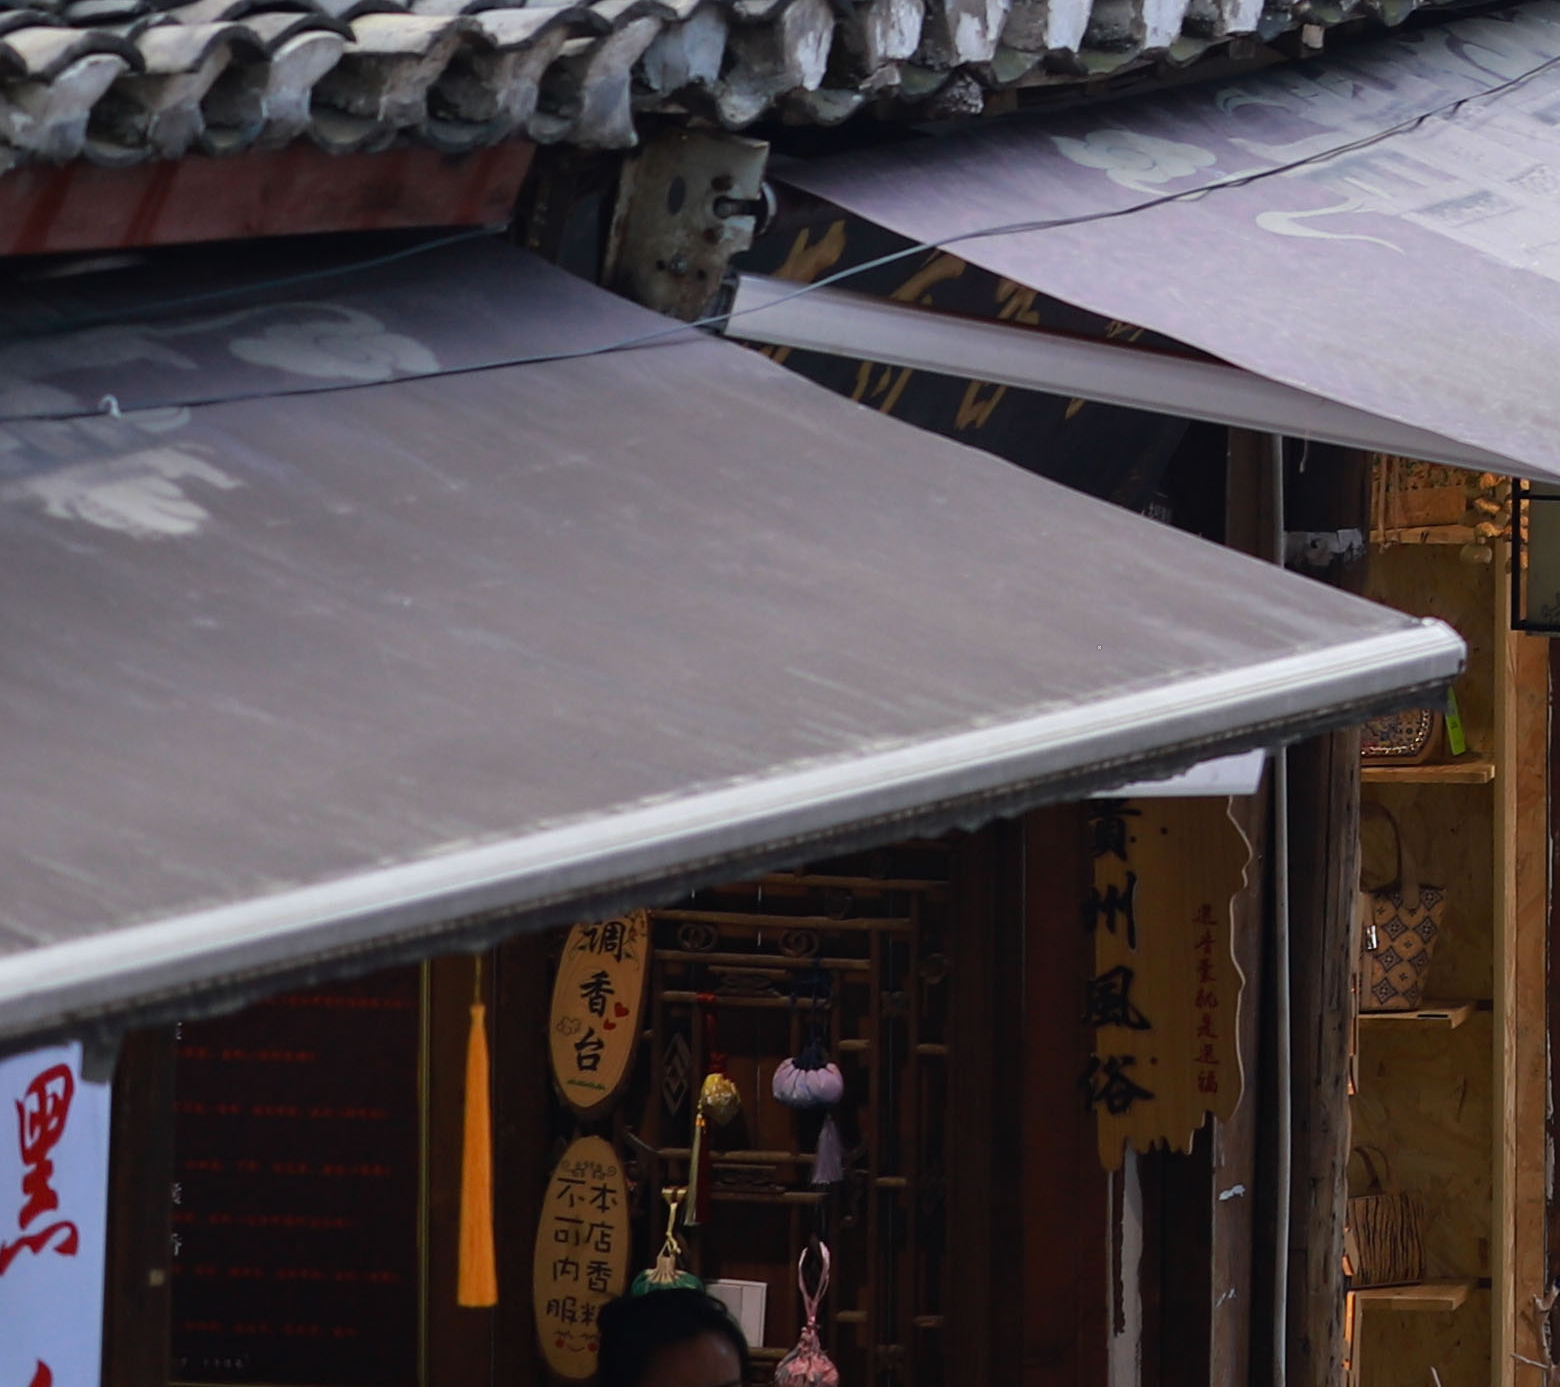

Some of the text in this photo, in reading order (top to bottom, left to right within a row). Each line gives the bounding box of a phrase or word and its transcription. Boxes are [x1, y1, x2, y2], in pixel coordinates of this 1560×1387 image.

[573, 920, 626, 1073] 调香台
[545, 1177, 584, 1326] 不可内服
